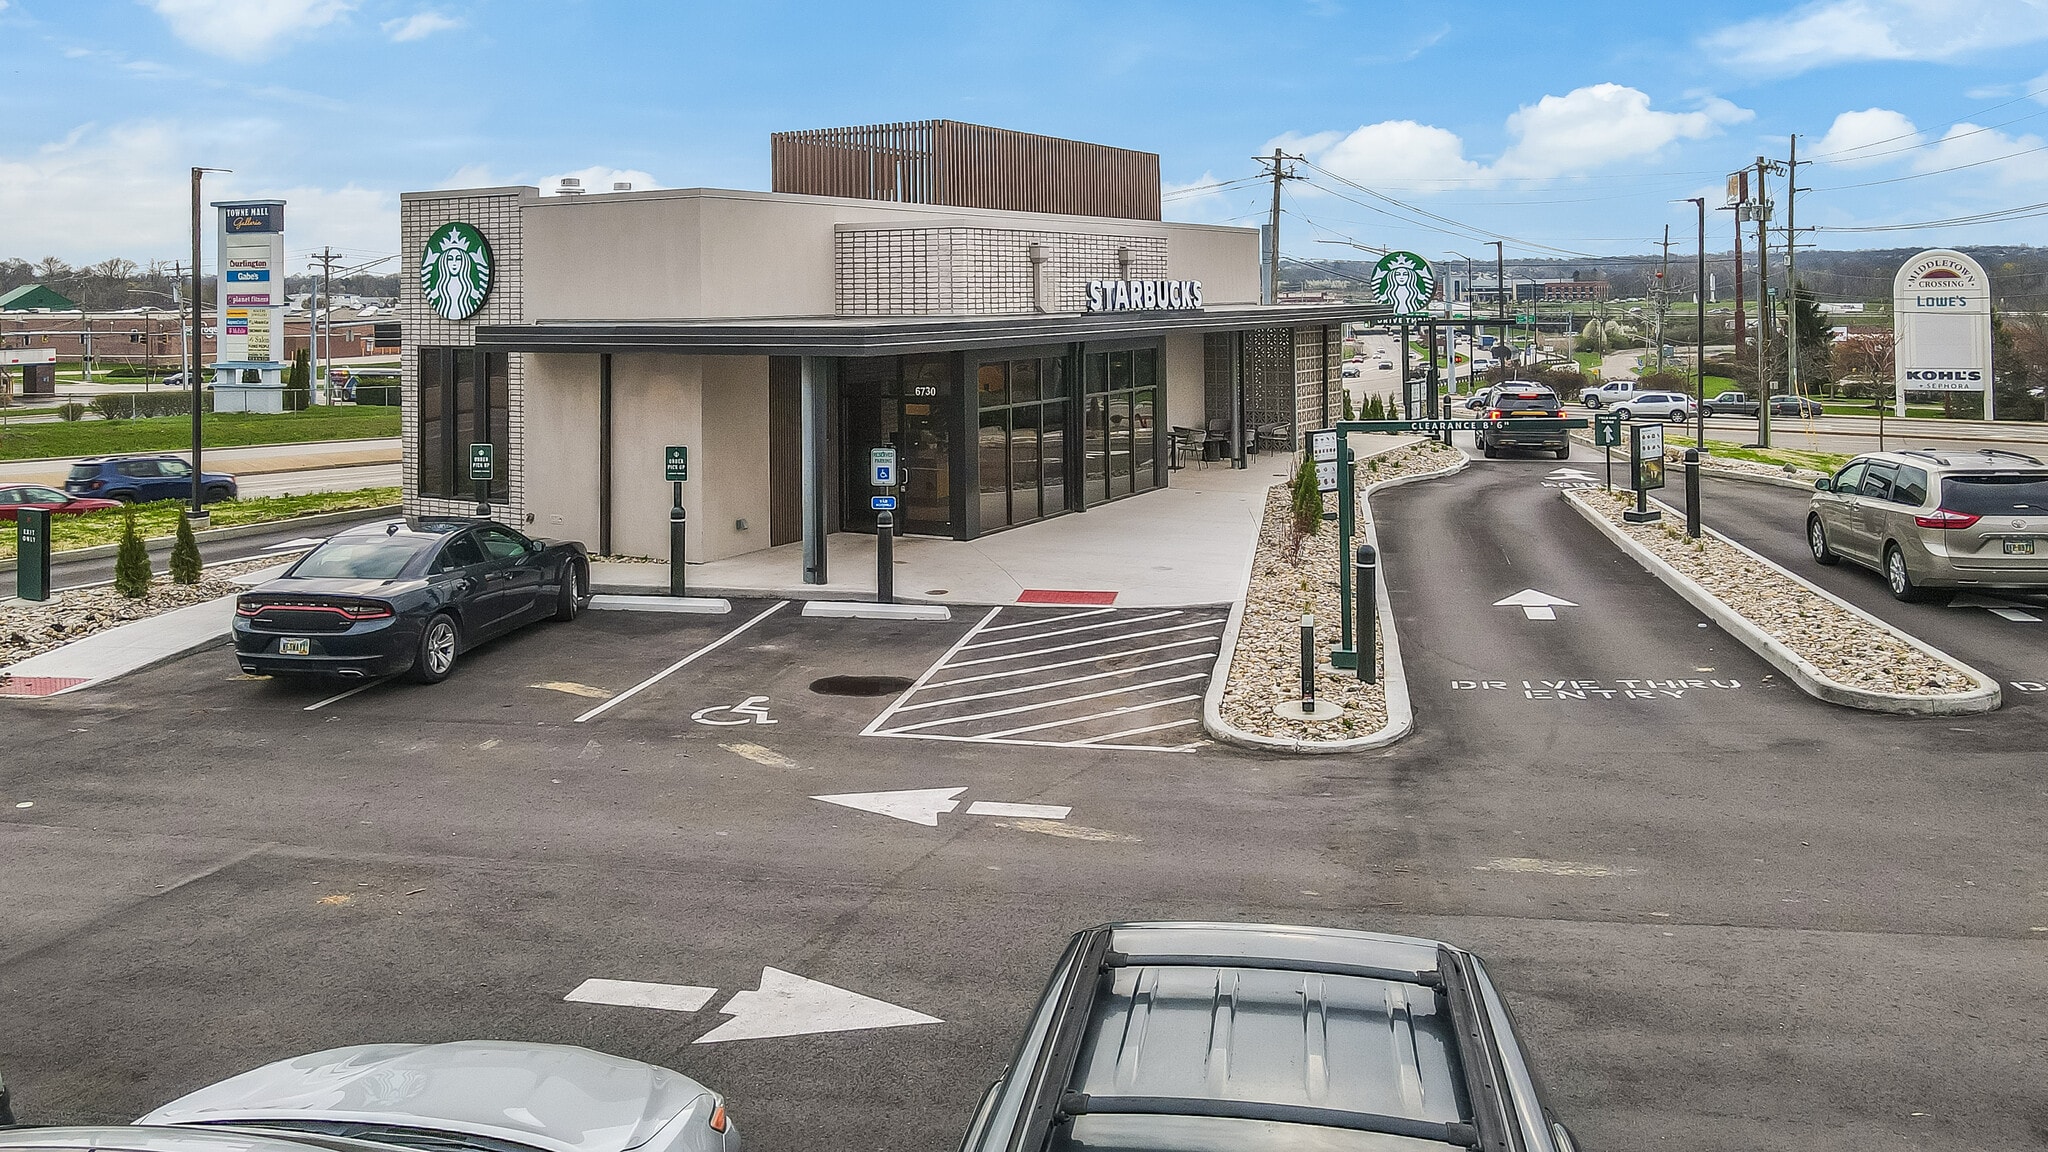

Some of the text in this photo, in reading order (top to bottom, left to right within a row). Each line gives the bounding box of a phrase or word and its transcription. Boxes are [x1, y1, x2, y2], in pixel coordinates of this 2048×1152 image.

[227, 208, 269, 217] TOWNE MALL
[229, 259, 267, 269] Burlington
[1908, 260, 1976, 283] MIDDLETOWN
[1918, 280, 1964, 288] CROSSING
[232, 295, 250, 304] planet
[1088, 280, 1203, 312] STARBUCKS
[1916, 295, 1967, 307] LOWE'S
[1906, 371, 1981, 381] KOHL'S
[915, 386, 936, 396] 6730
[1411, 421, 1477, 430] CLEARANCE
[22, 535, 36, 543] ONLY
[1615, 680, 1742, 689] THRU
[2010, 681, 2048, 692] D
[1524, 689, 1685, 700] ENTRY
